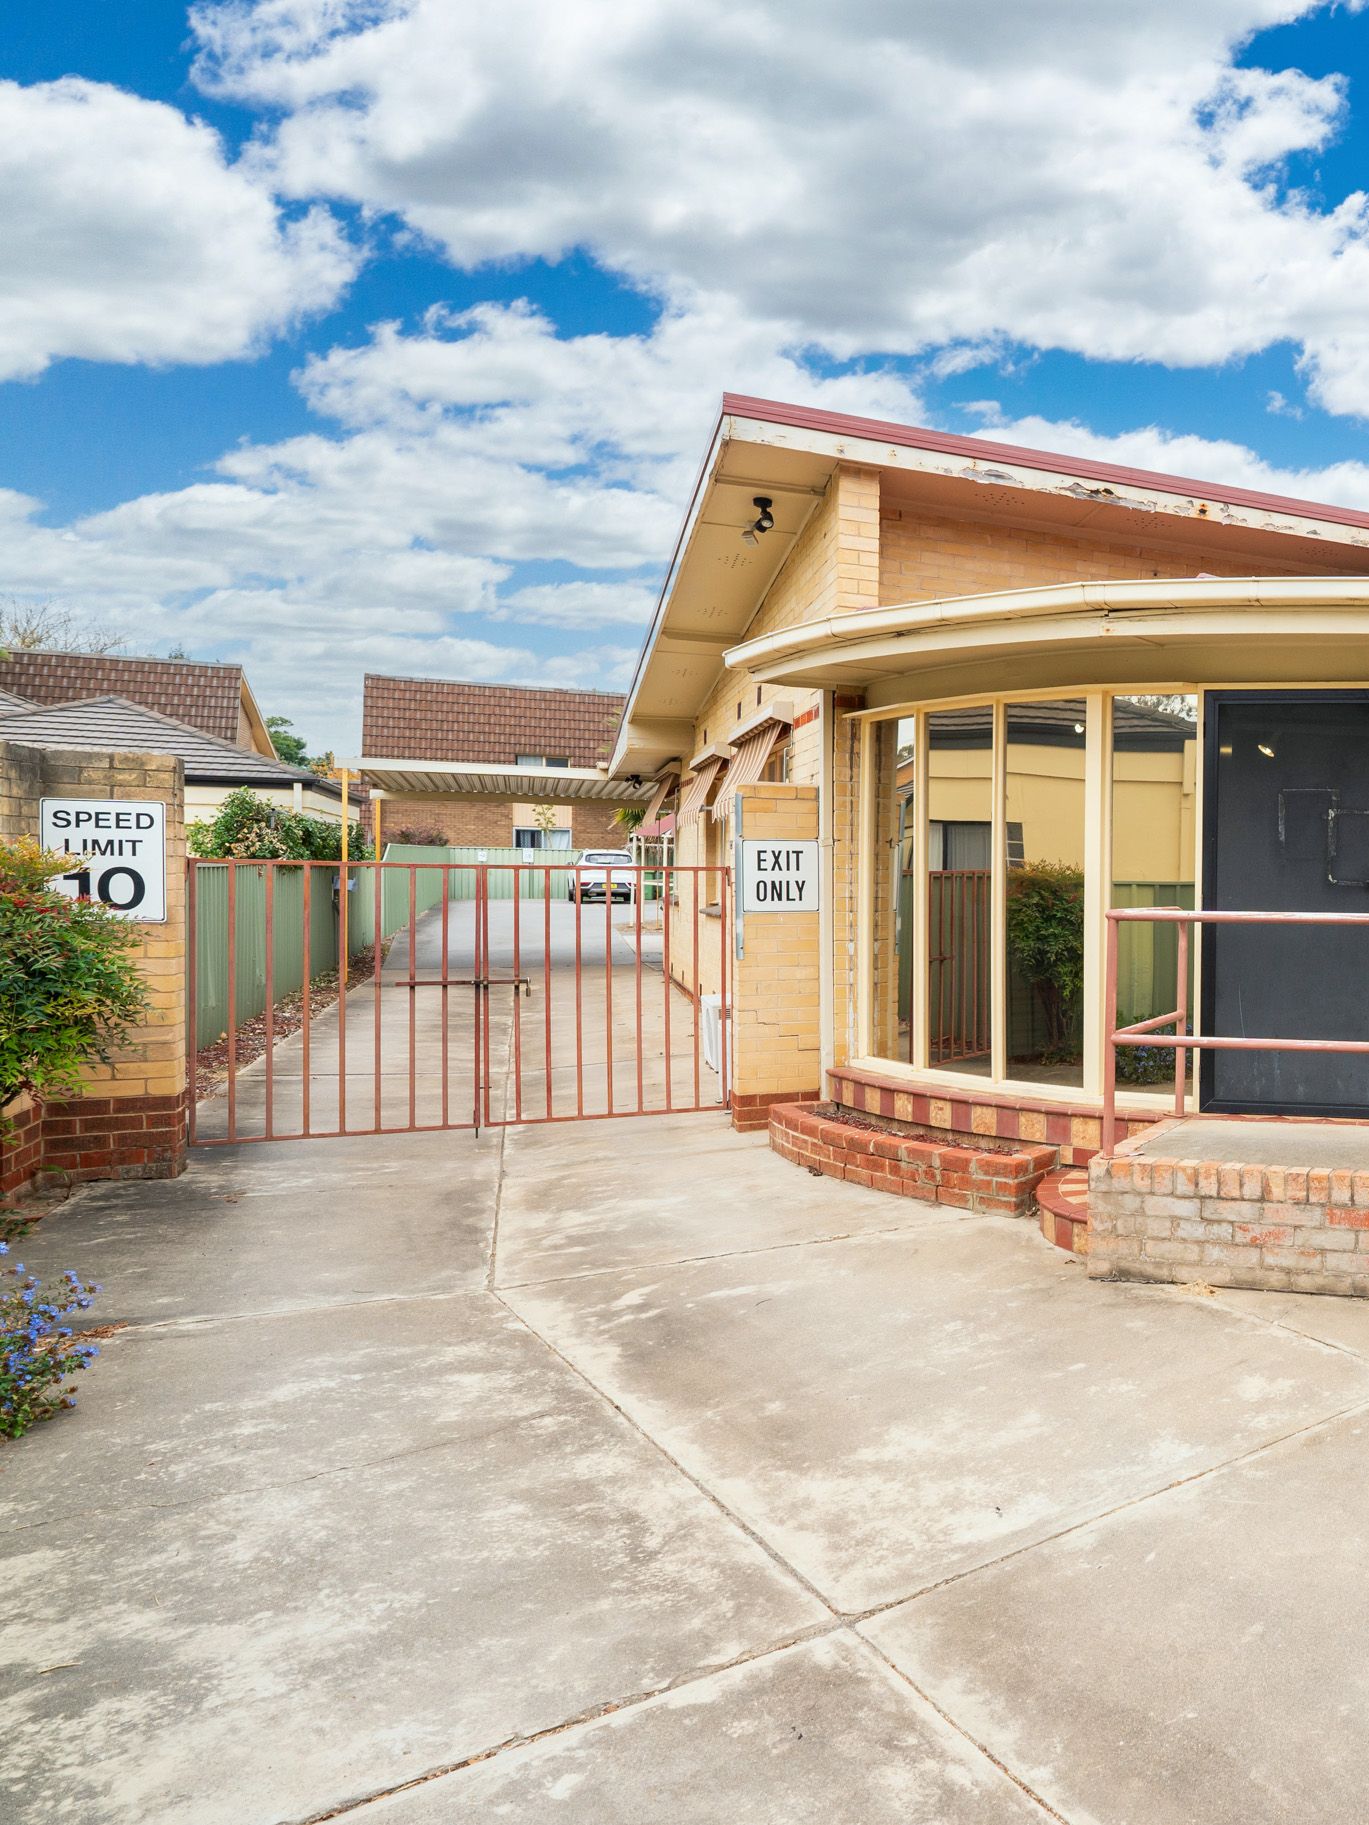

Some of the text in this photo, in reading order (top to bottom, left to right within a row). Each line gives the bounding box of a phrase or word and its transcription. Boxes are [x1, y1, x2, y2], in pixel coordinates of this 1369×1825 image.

[51, 810, 155, 830] SPEED
[64, 838, 143, 857] LIMIT
[757, 850, 804, 871] EXIT
[63, 866, 146, 911] 10
[756, 880, 806, 902] ONLY
